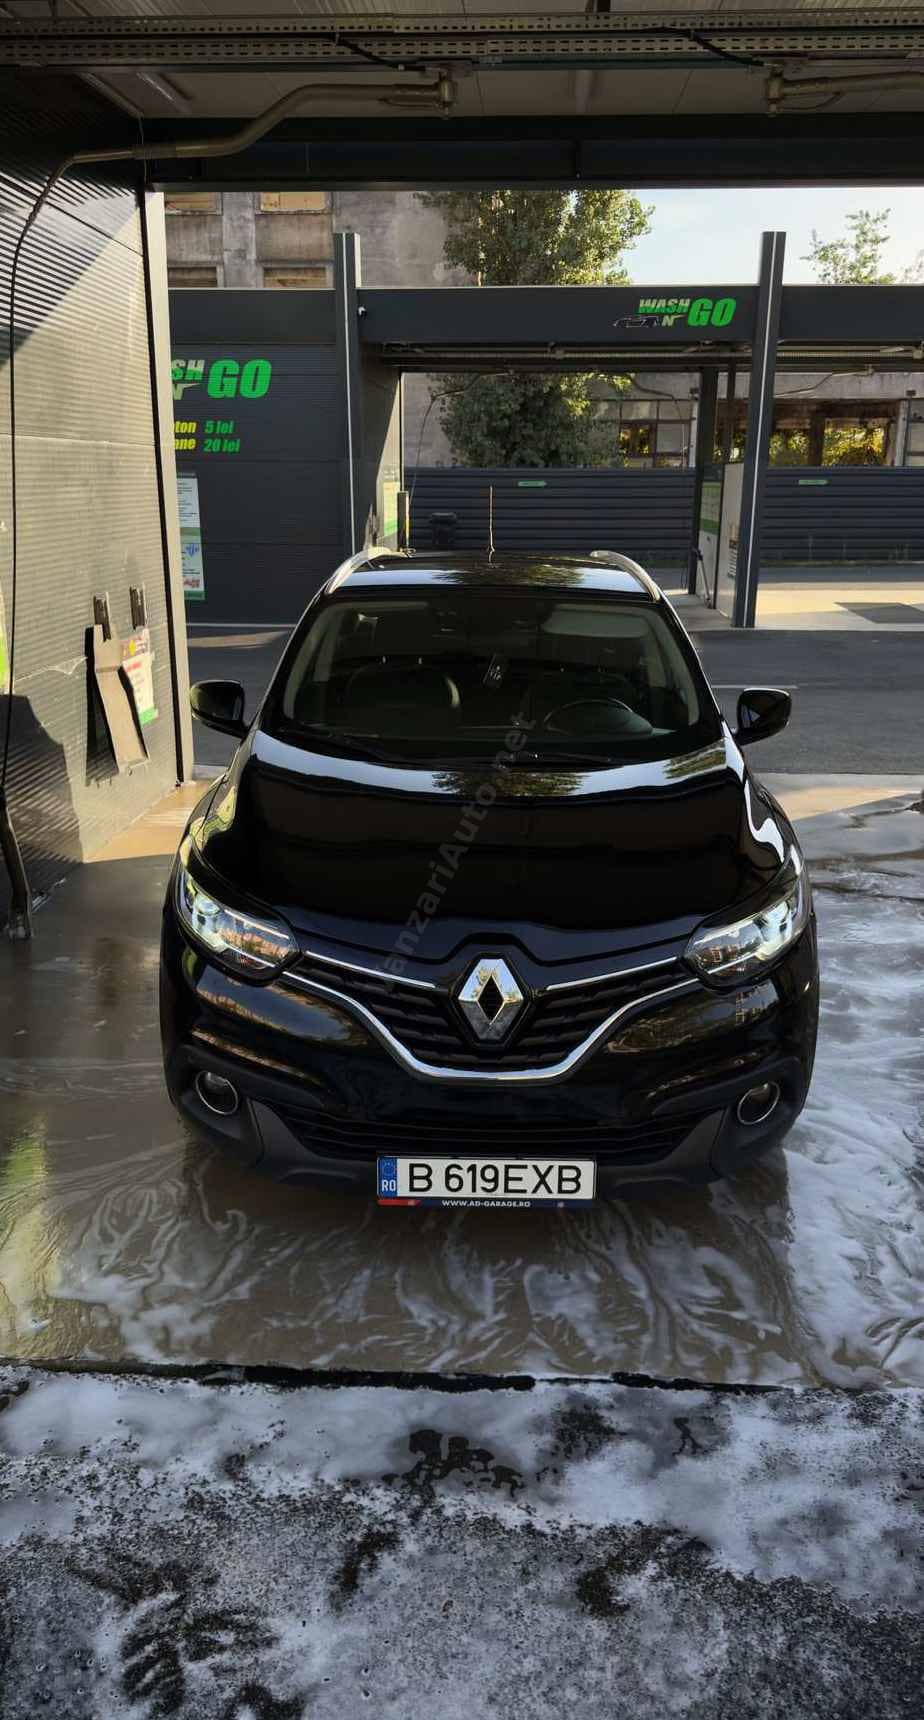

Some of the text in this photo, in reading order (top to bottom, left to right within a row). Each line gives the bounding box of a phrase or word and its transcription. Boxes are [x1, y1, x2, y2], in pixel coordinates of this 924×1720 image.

[639, 298, 691, 314] WASH
[687, 298, 737, 327] GO
[171, 359, 206, 380] SH
[207, 358, 272, 399] GO
[175, 419, 235, 434] ton 5 lei
[203, 438, 221, 453] 20
[222, 438, 241, 453] lei
[381, 1178, 396, 1192] RO
[408, 1163, 582, 1195] B 619EXB
[441, 1199, 531, 1208] WWW.AD-GARAGE.RO
